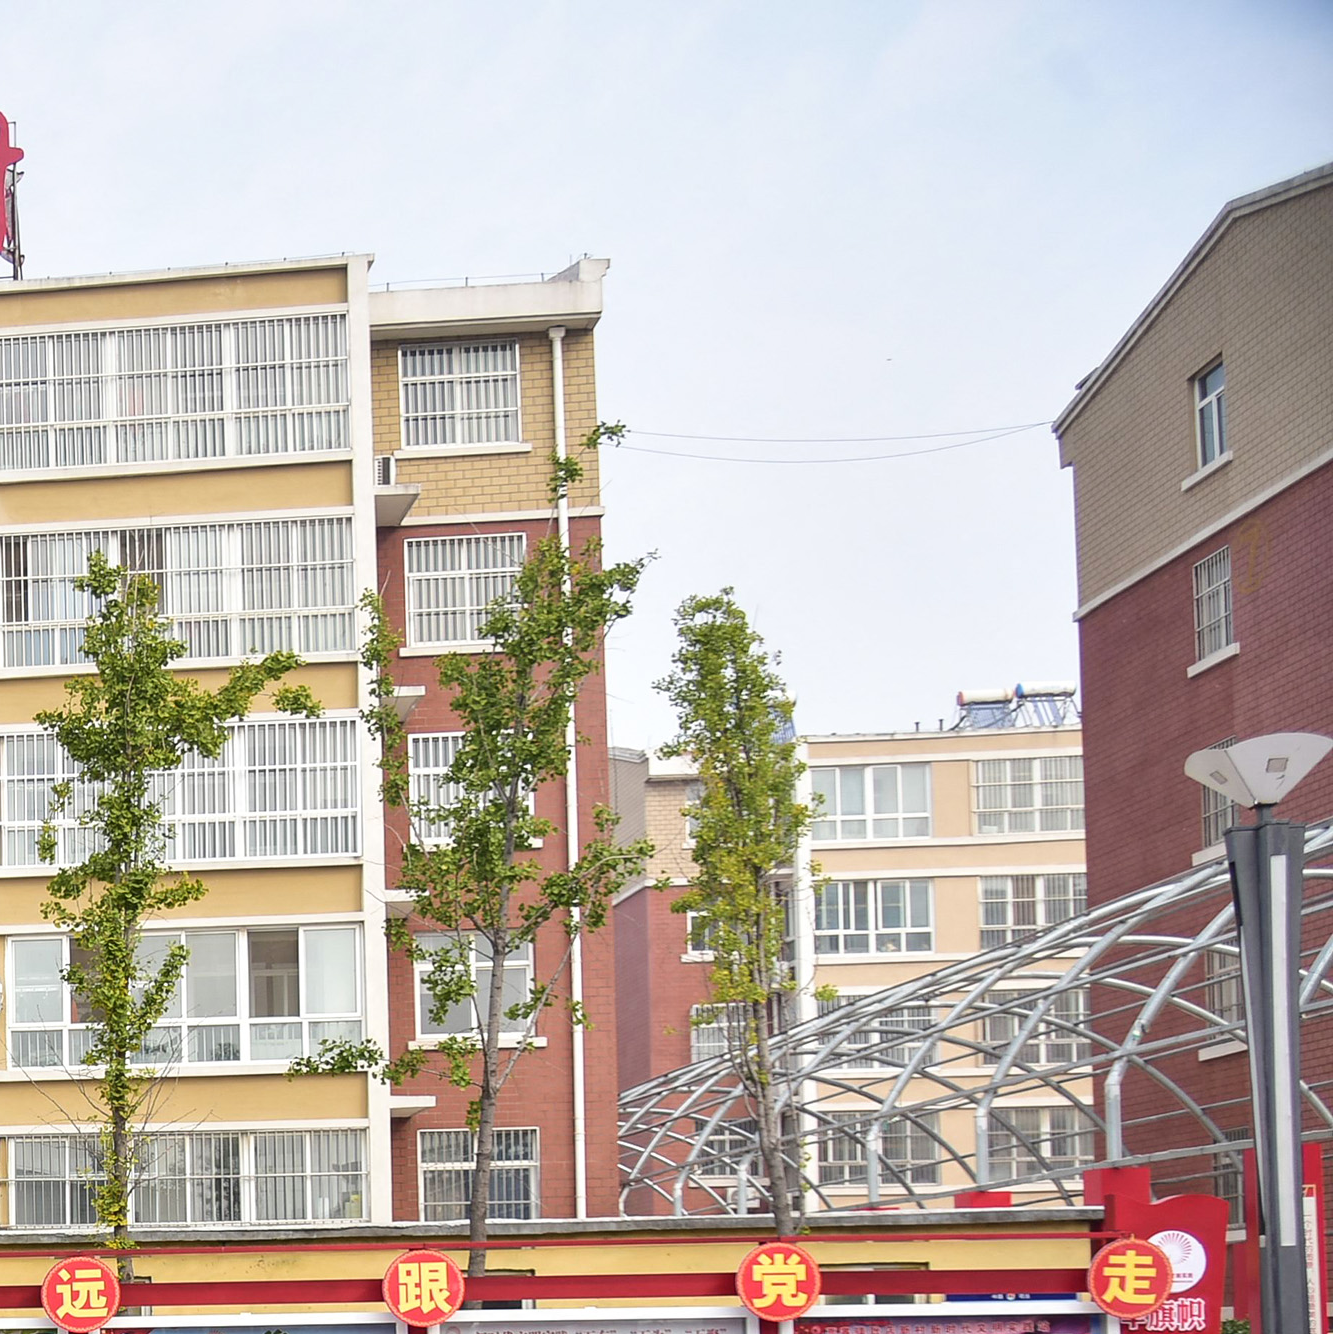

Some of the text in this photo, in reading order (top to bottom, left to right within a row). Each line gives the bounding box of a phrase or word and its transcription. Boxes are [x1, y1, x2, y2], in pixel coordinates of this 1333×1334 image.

[55, 1268, 108, 1317] 远
[398, 1261, 452, 1315] 跟
[751, 1254, 808, 1308] 党
[1101, 1250, 1157, 1304] 走
